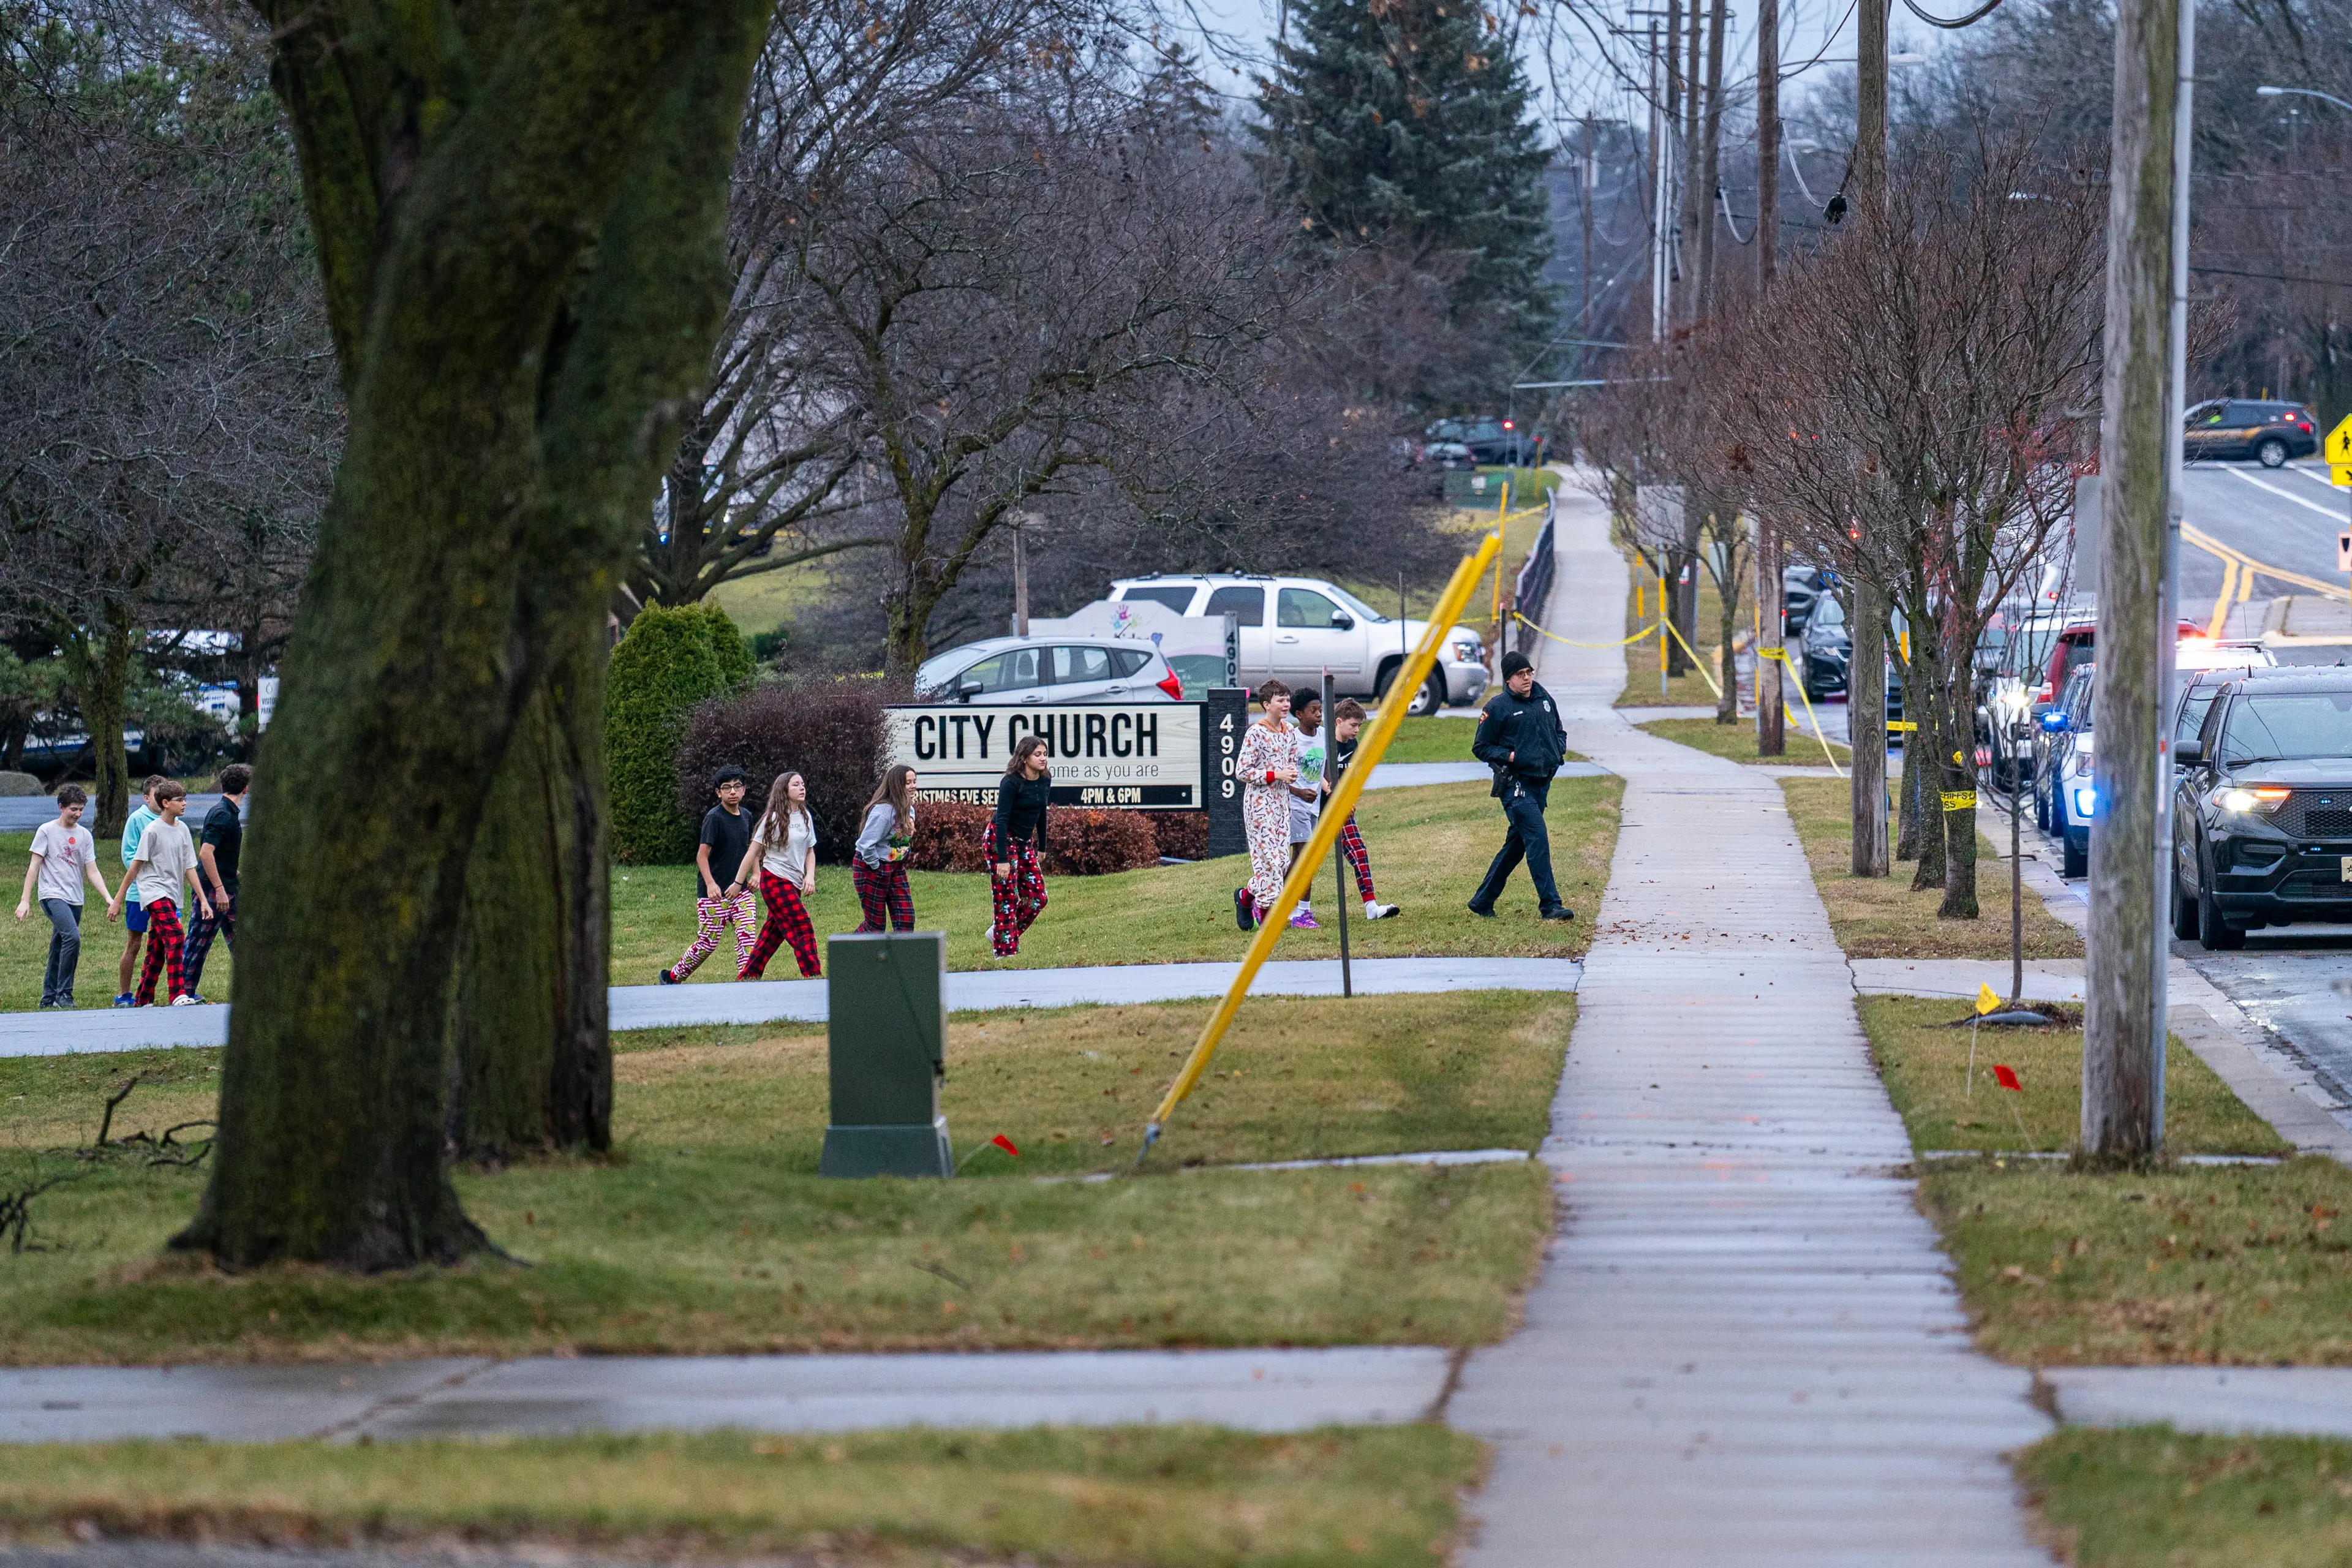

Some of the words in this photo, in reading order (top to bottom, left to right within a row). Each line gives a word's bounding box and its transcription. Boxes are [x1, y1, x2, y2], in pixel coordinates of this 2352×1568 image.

[915, 715, 995, 760] CITY
[1009, 712, 1158, 758] CHURCH
[1049, 766, 1079, 778] ome
[1084, 766, 1100, 778] as
[1105, 765, 1130, 780] you
[1136, 764, 1159, 777] are
[1219, 714, 1235, 798] 4909
[912, 790, 957, 805] RISTMAS
[1080, 788, 1104, 804] 4PM
[1106, 788, 1115, 804] &
[1118, 788, 1141, 803] 6PM
